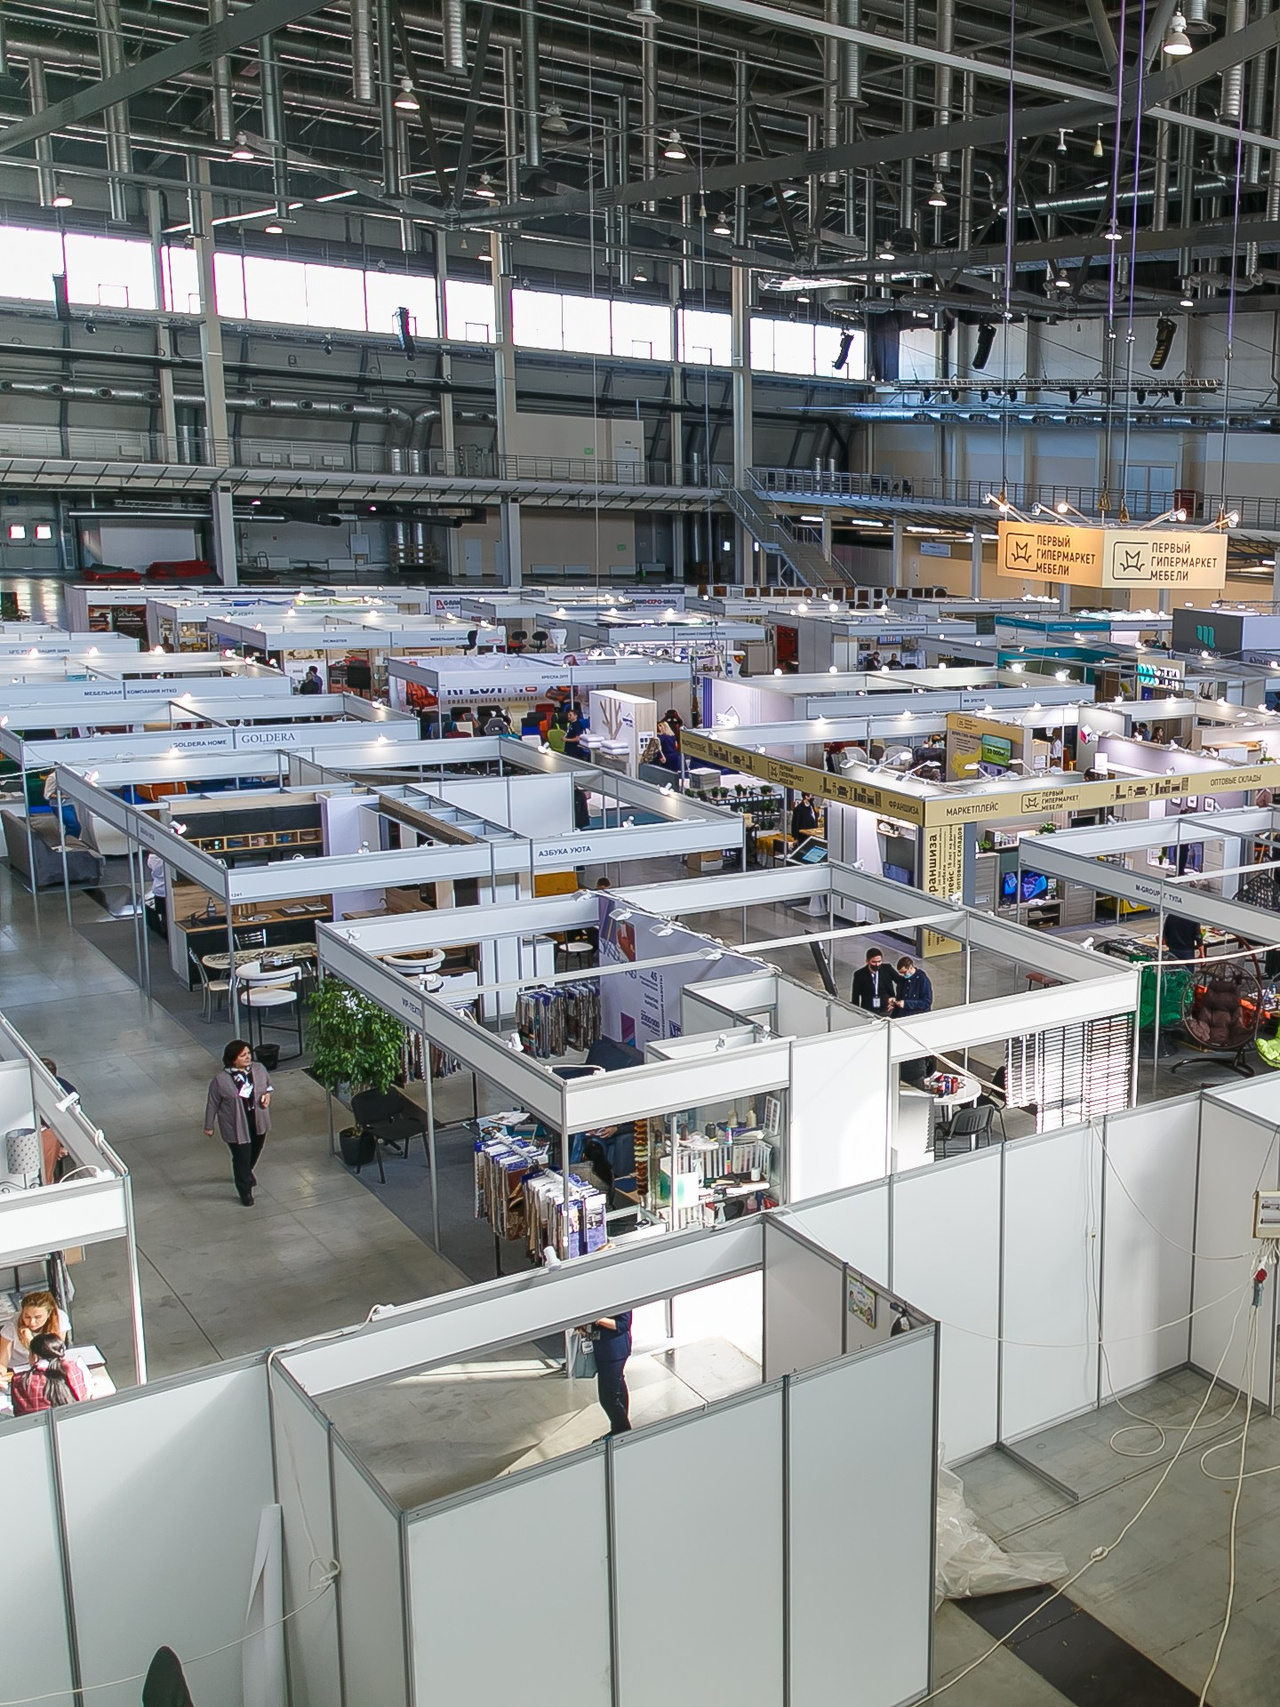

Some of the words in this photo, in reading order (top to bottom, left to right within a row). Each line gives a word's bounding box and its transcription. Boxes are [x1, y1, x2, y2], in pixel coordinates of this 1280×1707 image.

[1036, 534, 1071, 548] ПЕРВЫЙ
[1151, 540, 1191, 554] ПЕРВЫЙ
[1036, 548, 1096, 565] ГИПЕРМАРКЕТ
[1150, 556, 1218, 569] ГИПЕРМАРКЕТ
[1035, 562, 1070, 576] МЕБЕЛИ
[1150, 570, 1189, 581] МЕБЕЛИ
[173, 740, 206, 748] GOLDERA
[241, 732, 296, 744] GOLDERA
[1210, 776, 1237, 787] ОПТОВЫЕ
[1238, 774, 1262, 783] СКЛАДЫ
[1041, 789, 1064, 798] ПЕРВЫЙ
[1041, 794, 1079, 804] ГИПЕРМАРКЕТ
[888, 799, 920, 816] ФРАНШИЗА
[945, 802, 999, 817] МАРКЕТПЛЕЙС
[1041, 803, 1064, 811] МЕБЕЛИ
[538, 848, 569, 857] АЗБУКА
[569, 845, 592, 853] УЮТА
[928, 834, 938, 896] раншиза
[1168, 893, 1183, 903] ТУЛА
